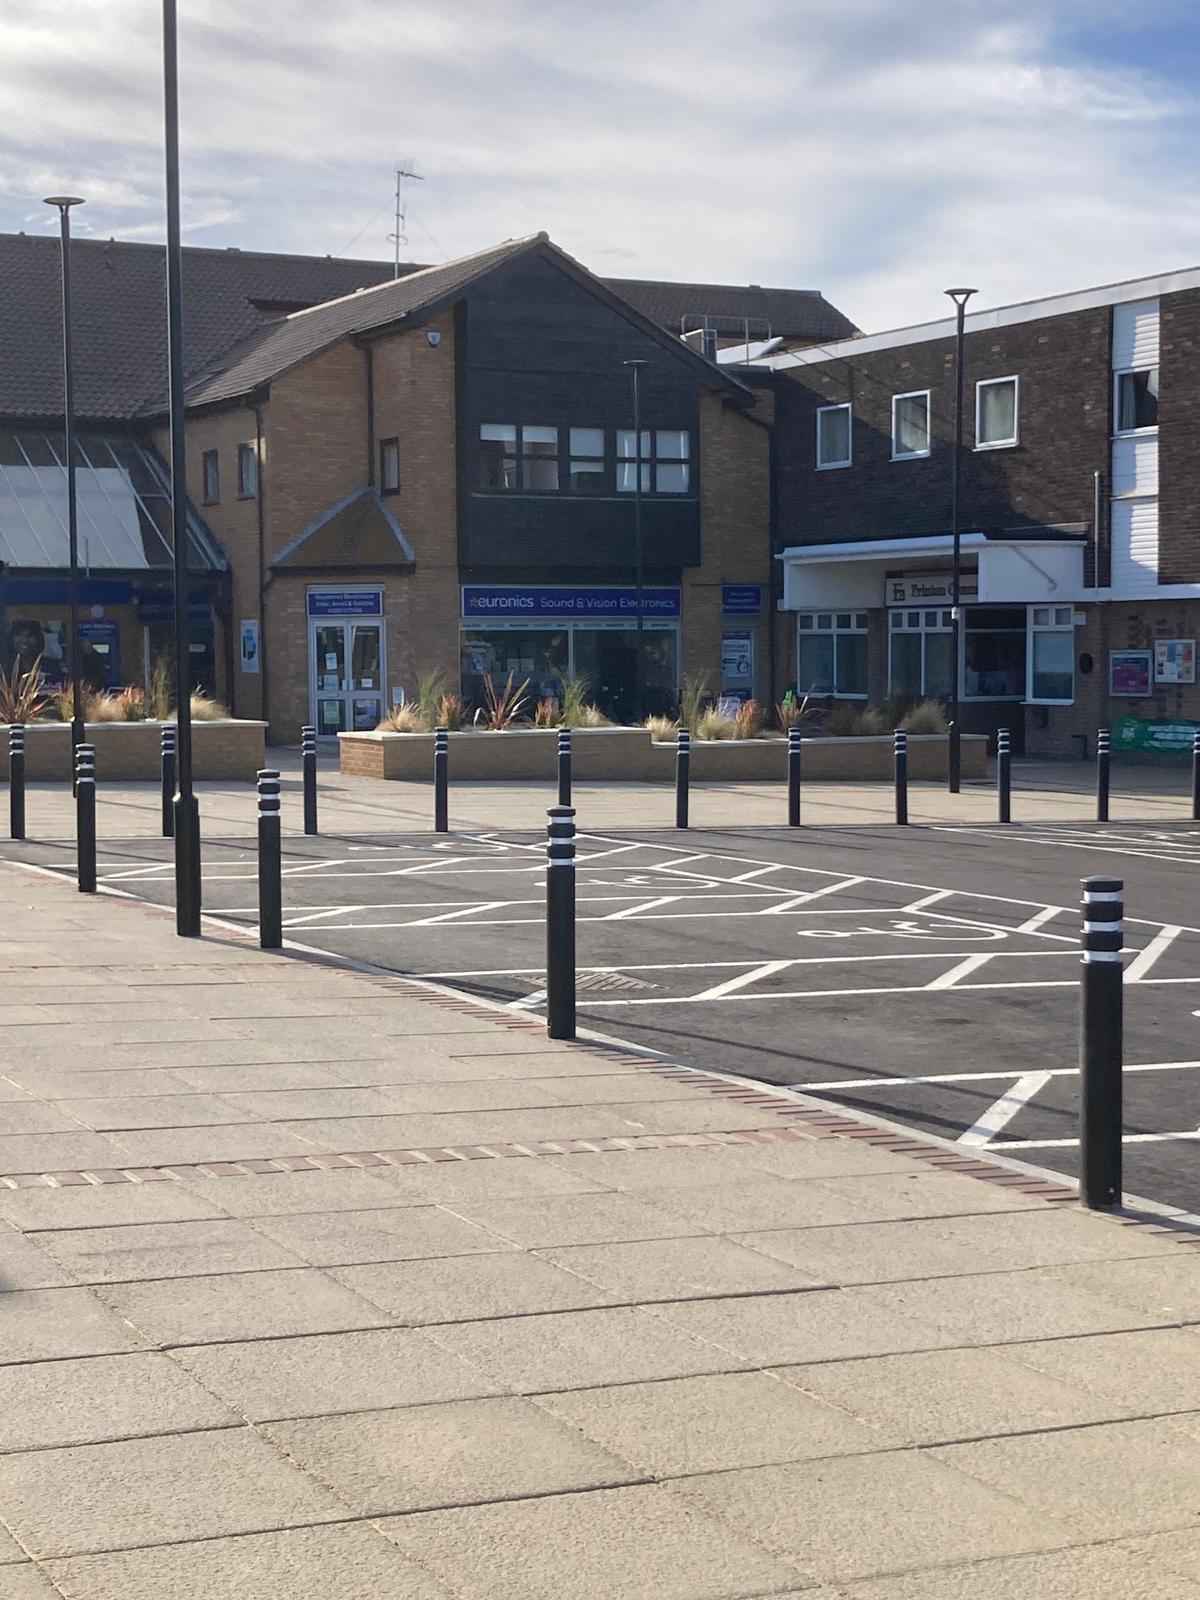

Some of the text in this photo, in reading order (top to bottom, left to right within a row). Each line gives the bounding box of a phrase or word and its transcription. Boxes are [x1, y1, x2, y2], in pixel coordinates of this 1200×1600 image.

[479, 594, 535, 608] euronics
[540, 597, 574, 608] Sound
[576, 597, 584, 608] &
[585, 598, 617, 608] Vision
